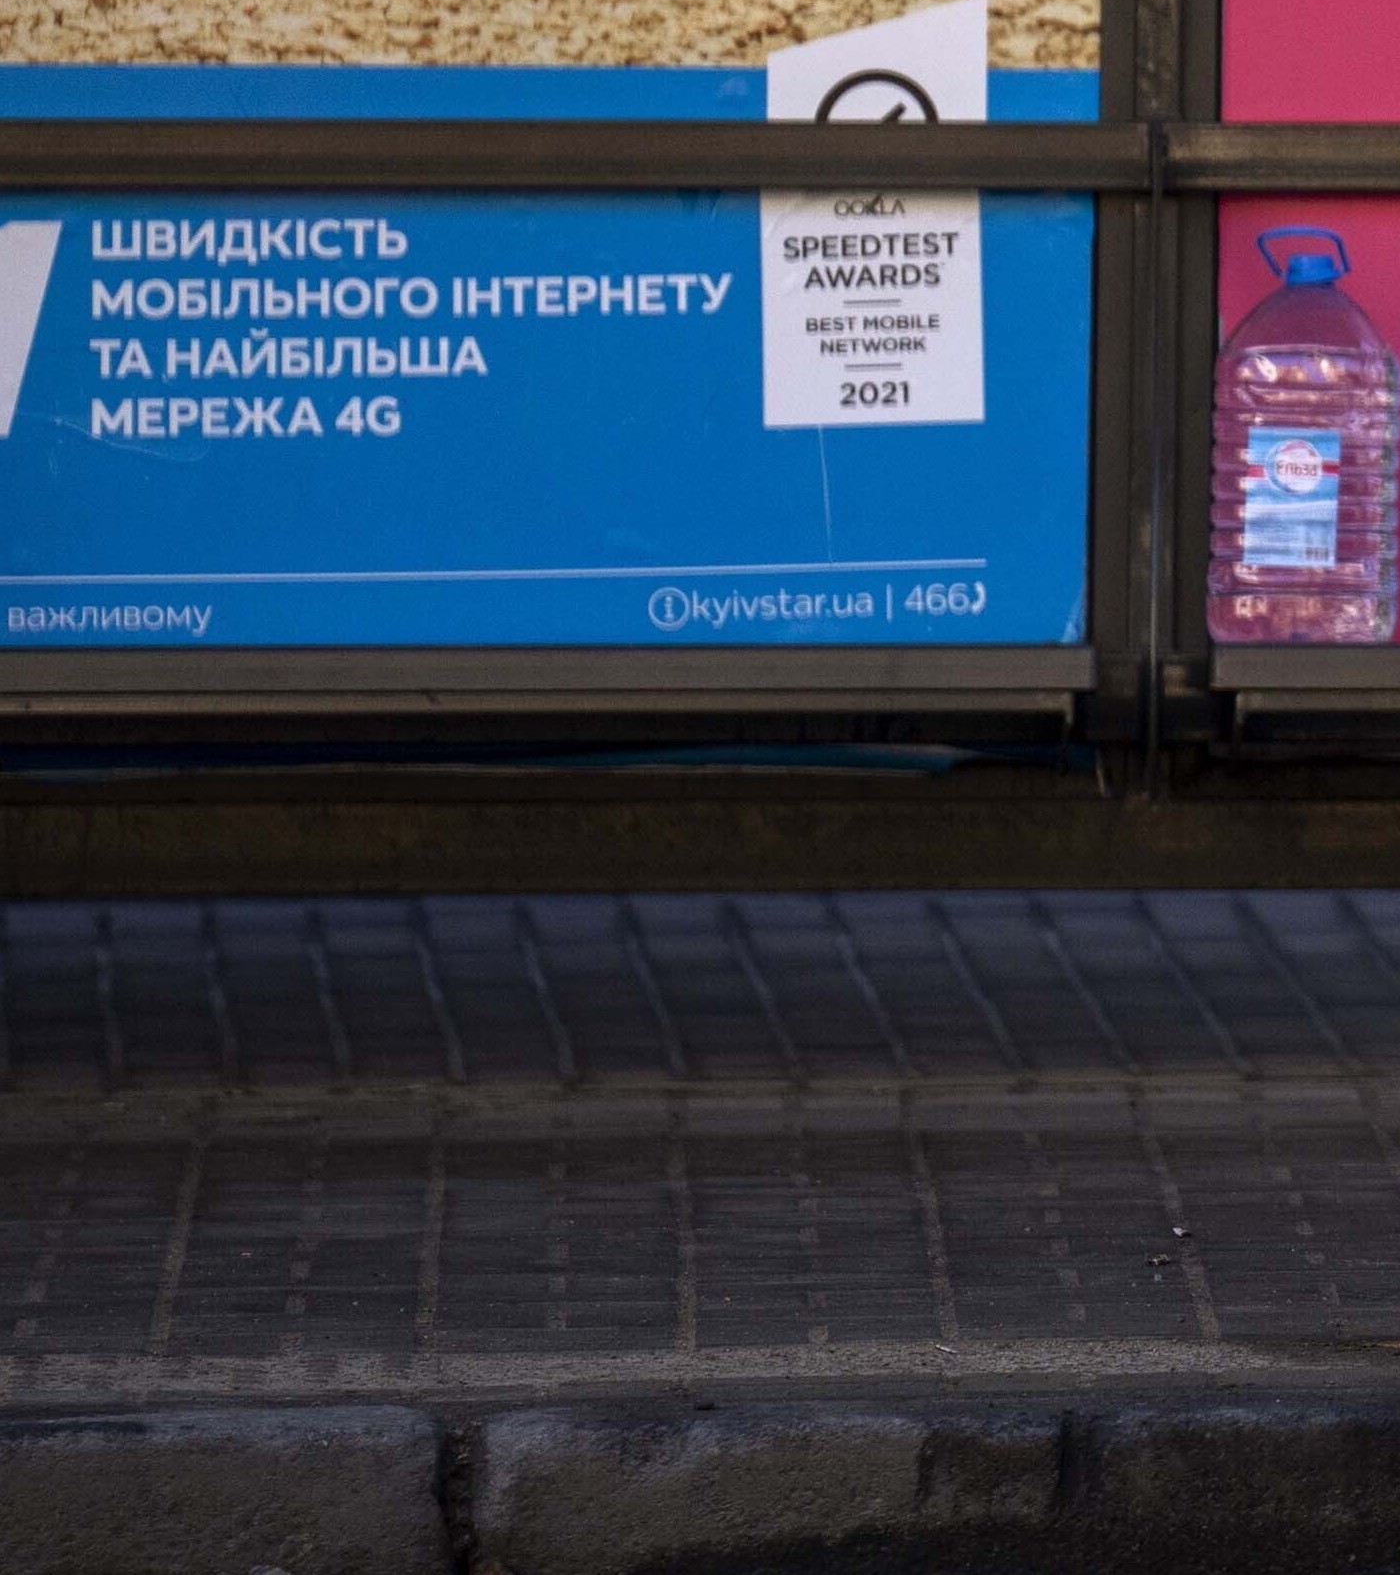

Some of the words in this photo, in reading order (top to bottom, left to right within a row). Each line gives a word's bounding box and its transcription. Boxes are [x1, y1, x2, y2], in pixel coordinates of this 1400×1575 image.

[91, 218, 408, 266] ШВИДКІСТЬ
[783, 232, 959, 260] SPEEDTEST
[804, 263, 940, 289] AWARDS
[91, 277, 439, 319] МОБІЛЬНОГО
[452, 273, 731, 316] ІНТЕРНЕТУ
[805, 316, 855, 333] BEST
[862, 315, 939, 331] MOBILE
[89, 338, 153, 378] ТА
[166, 328, 488, 378] НАЙБІЛЬША
[820, 337, 926, 354] NETWORK
[840, 381, 909, 407] 2021
[91, 397, 323, 439] МЕРЕЖА
[335, 395, 401, 436] 4G
[7, 605, 212, 637] важливому
